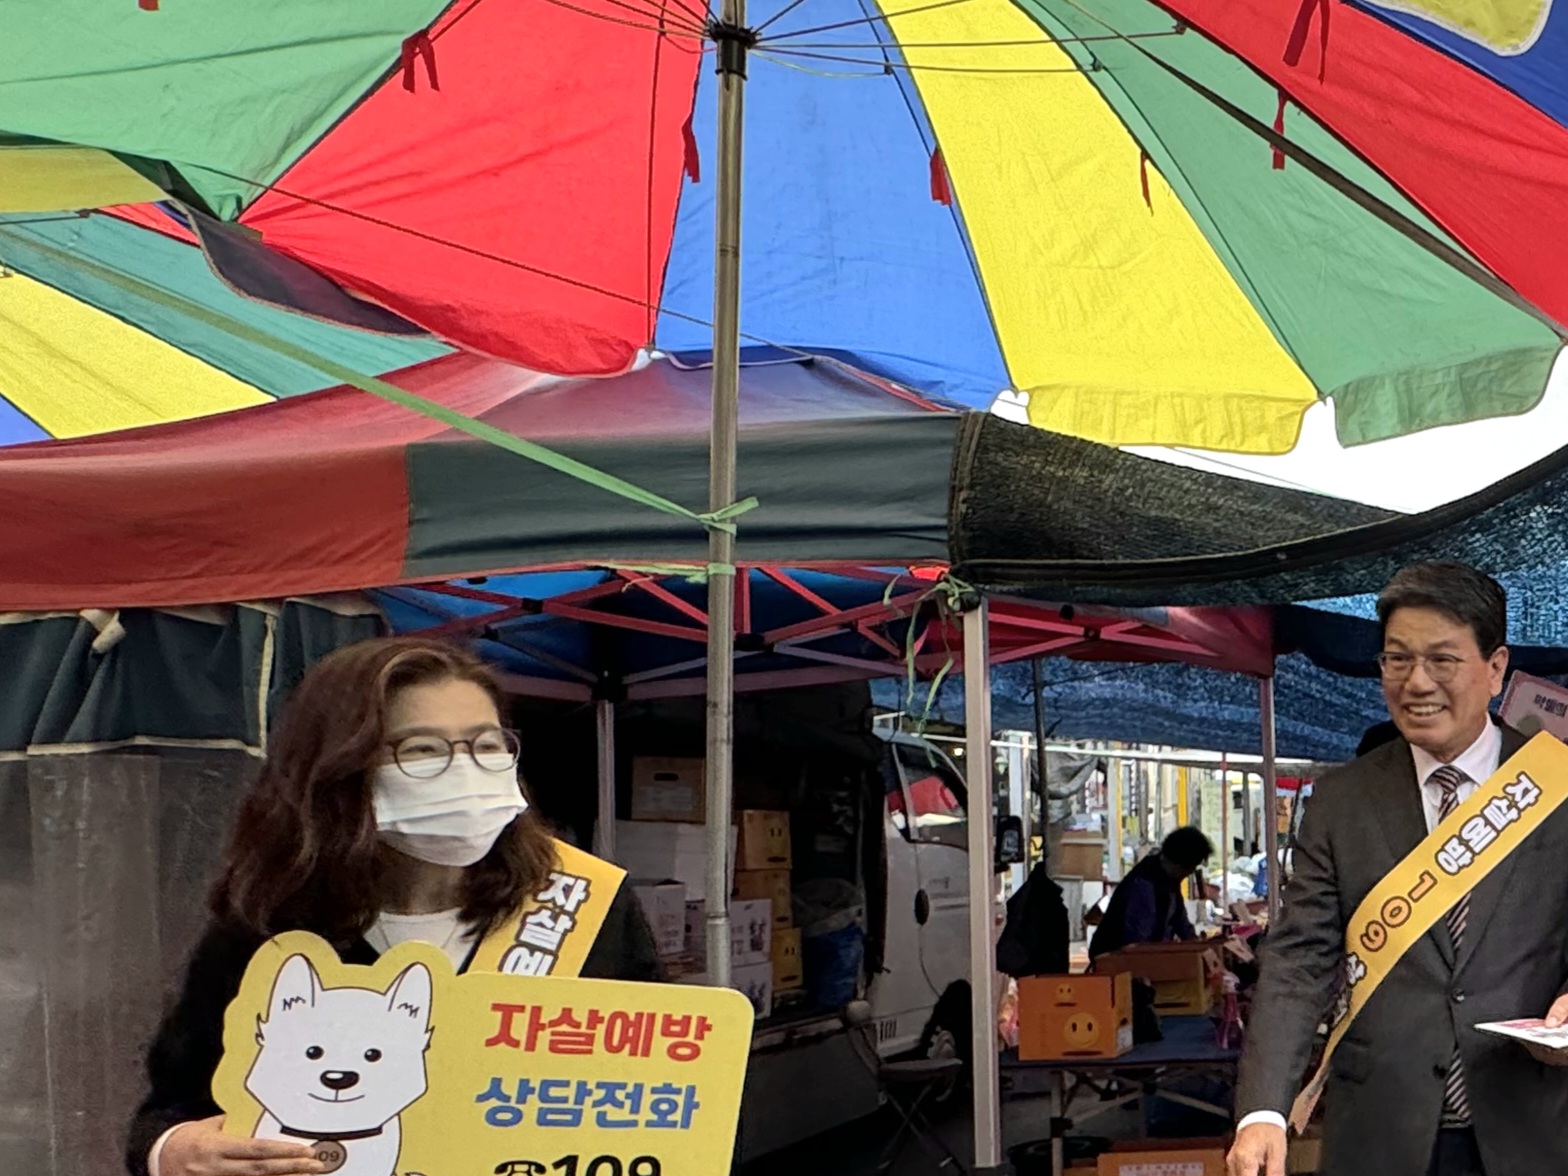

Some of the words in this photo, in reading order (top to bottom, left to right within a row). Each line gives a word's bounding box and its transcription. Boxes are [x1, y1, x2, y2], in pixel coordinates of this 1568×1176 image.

[1433, 770, 1543, 877] 자살예방
[1360, 870, 1438, 953] 109
[485, 1003, 712, 1062] 자살예방
[476, 1077, 700, 1130] 상담전화
[315, 1150, 340, 1162] 09
